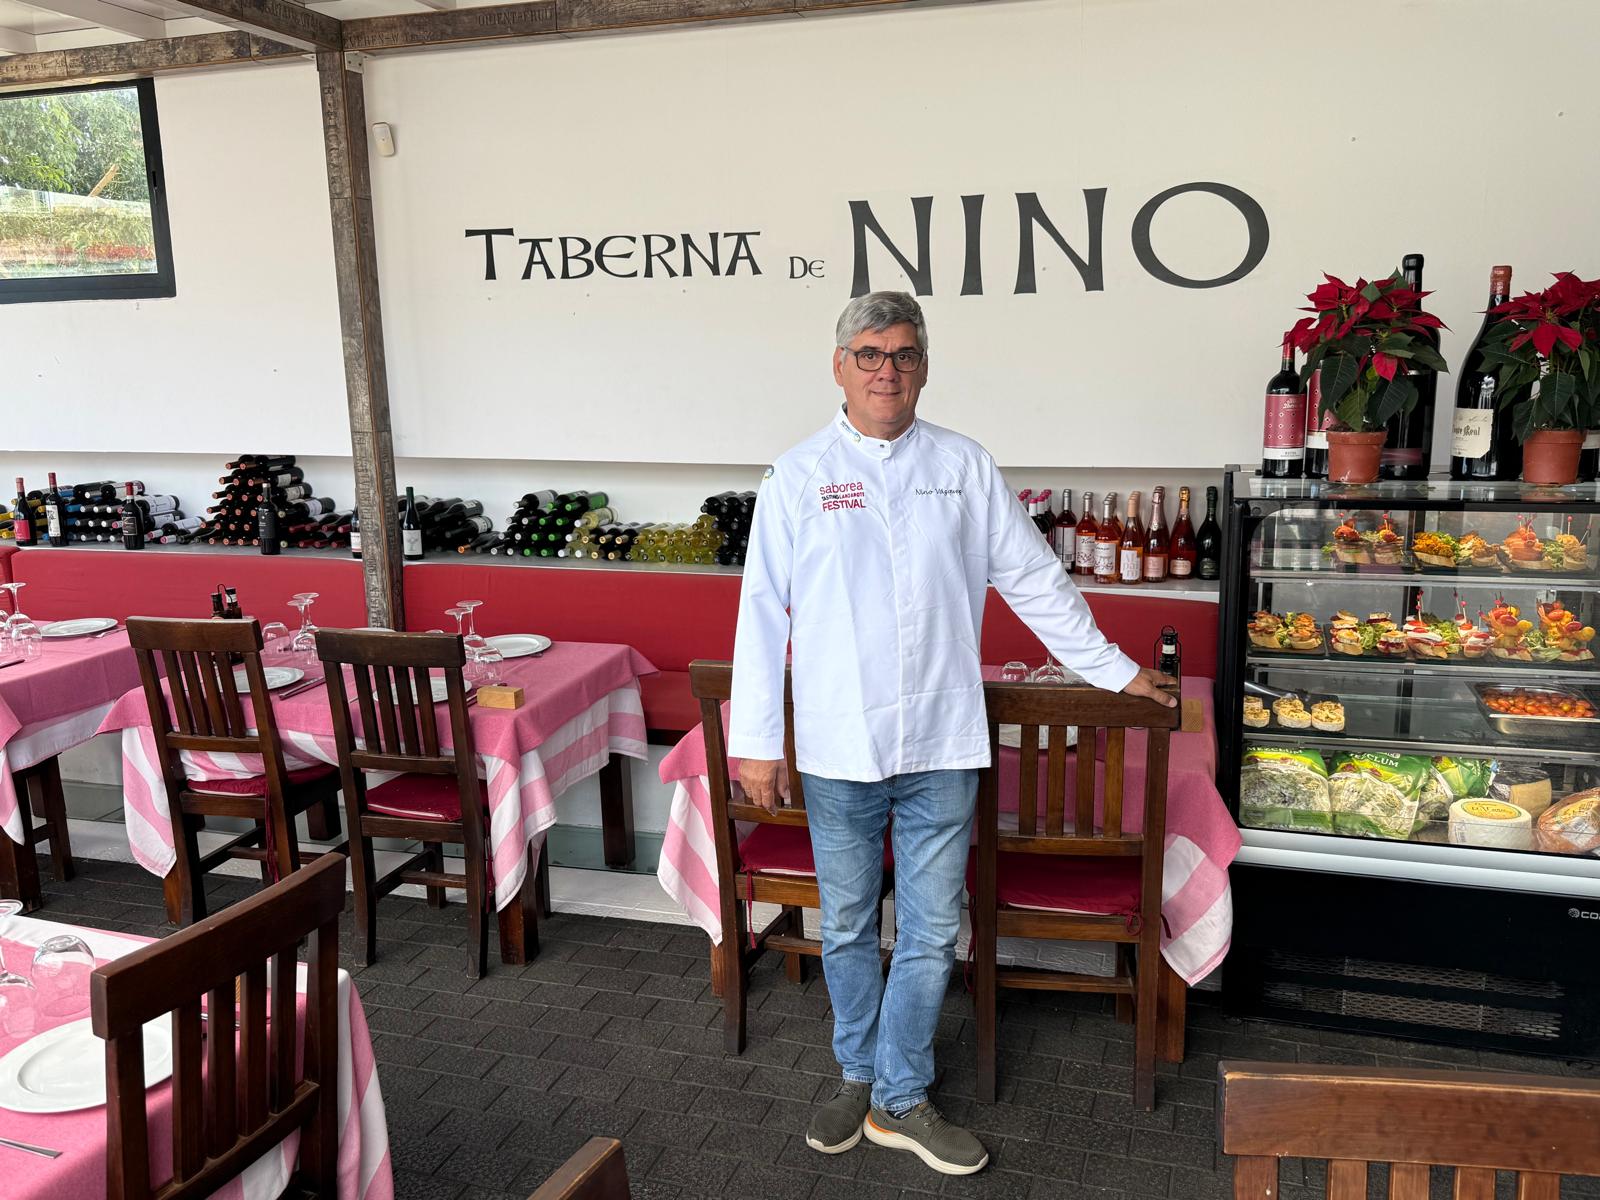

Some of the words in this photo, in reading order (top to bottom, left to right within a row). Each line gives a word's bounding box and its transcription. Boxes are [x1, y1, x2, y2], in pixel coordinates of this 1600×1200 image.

[465, 227, 762, 280] TABERNA
[789, 256, 825, 279] DE
[849, 182, 1270, 300] NINO
[819, 481, 864, 495] saborea
[822, 498, 867, 512] FESTIVAL
[1581, 910, 1600, 920] CO
